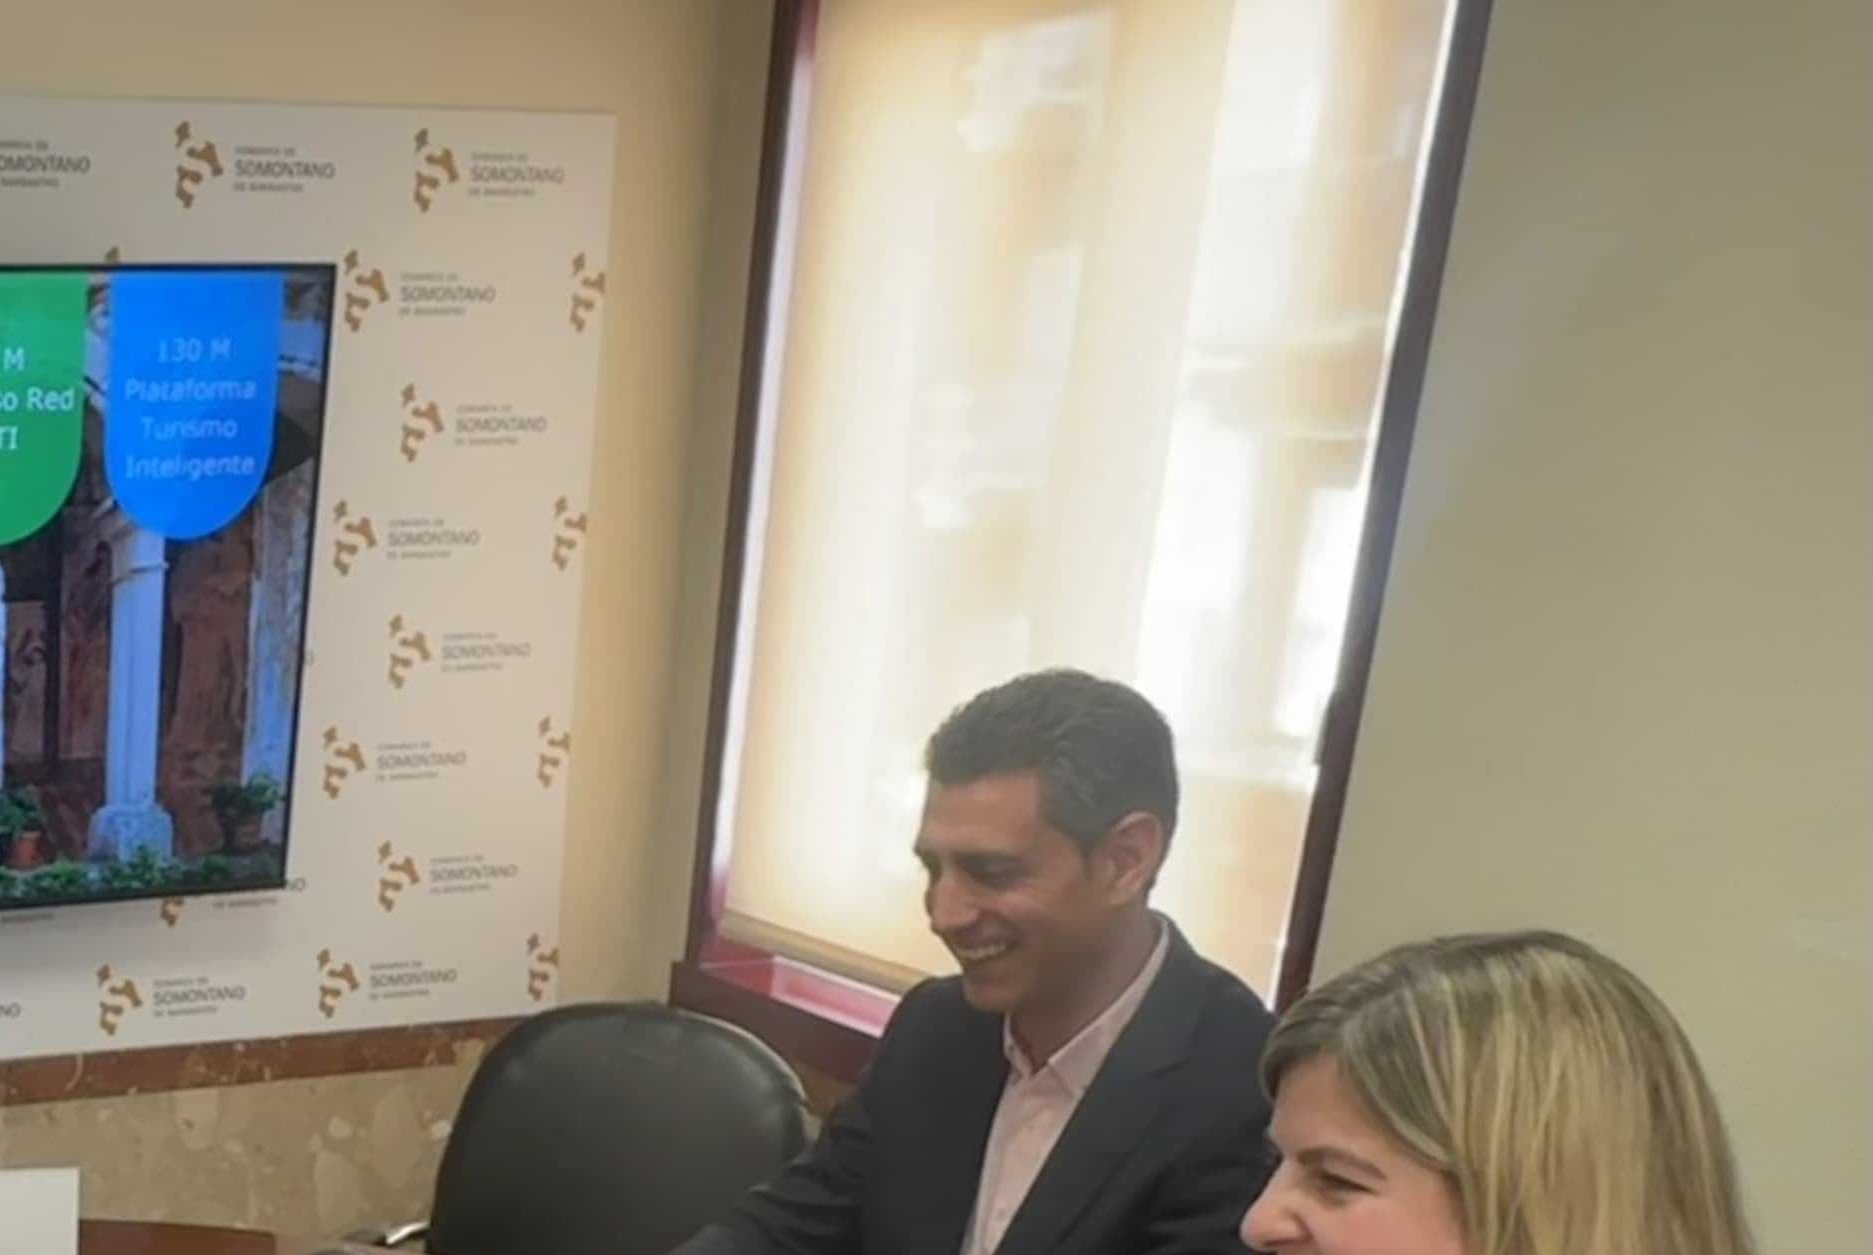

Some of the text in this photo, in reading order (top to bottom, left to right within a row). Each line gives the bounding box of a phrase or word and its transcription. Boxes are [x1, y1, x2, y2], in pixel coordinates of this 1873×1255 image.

[234, 158, 336, 180] SOMONTANO
[470, 166, 566, 185] SOMONTANO
[400, 285, 497, 304] SOMONTANO
[3, 348, 25, 371] M
[158, 338, 231, 362] 130 M
[27, 386, 75, 412] Red
[126, 378, 256, 402] Plataforma
[141, 416, 238, 439] Turismo
[126, 456, 256, 482] Inteligente
[152, 985, 247, 1006] SOMONTANO
